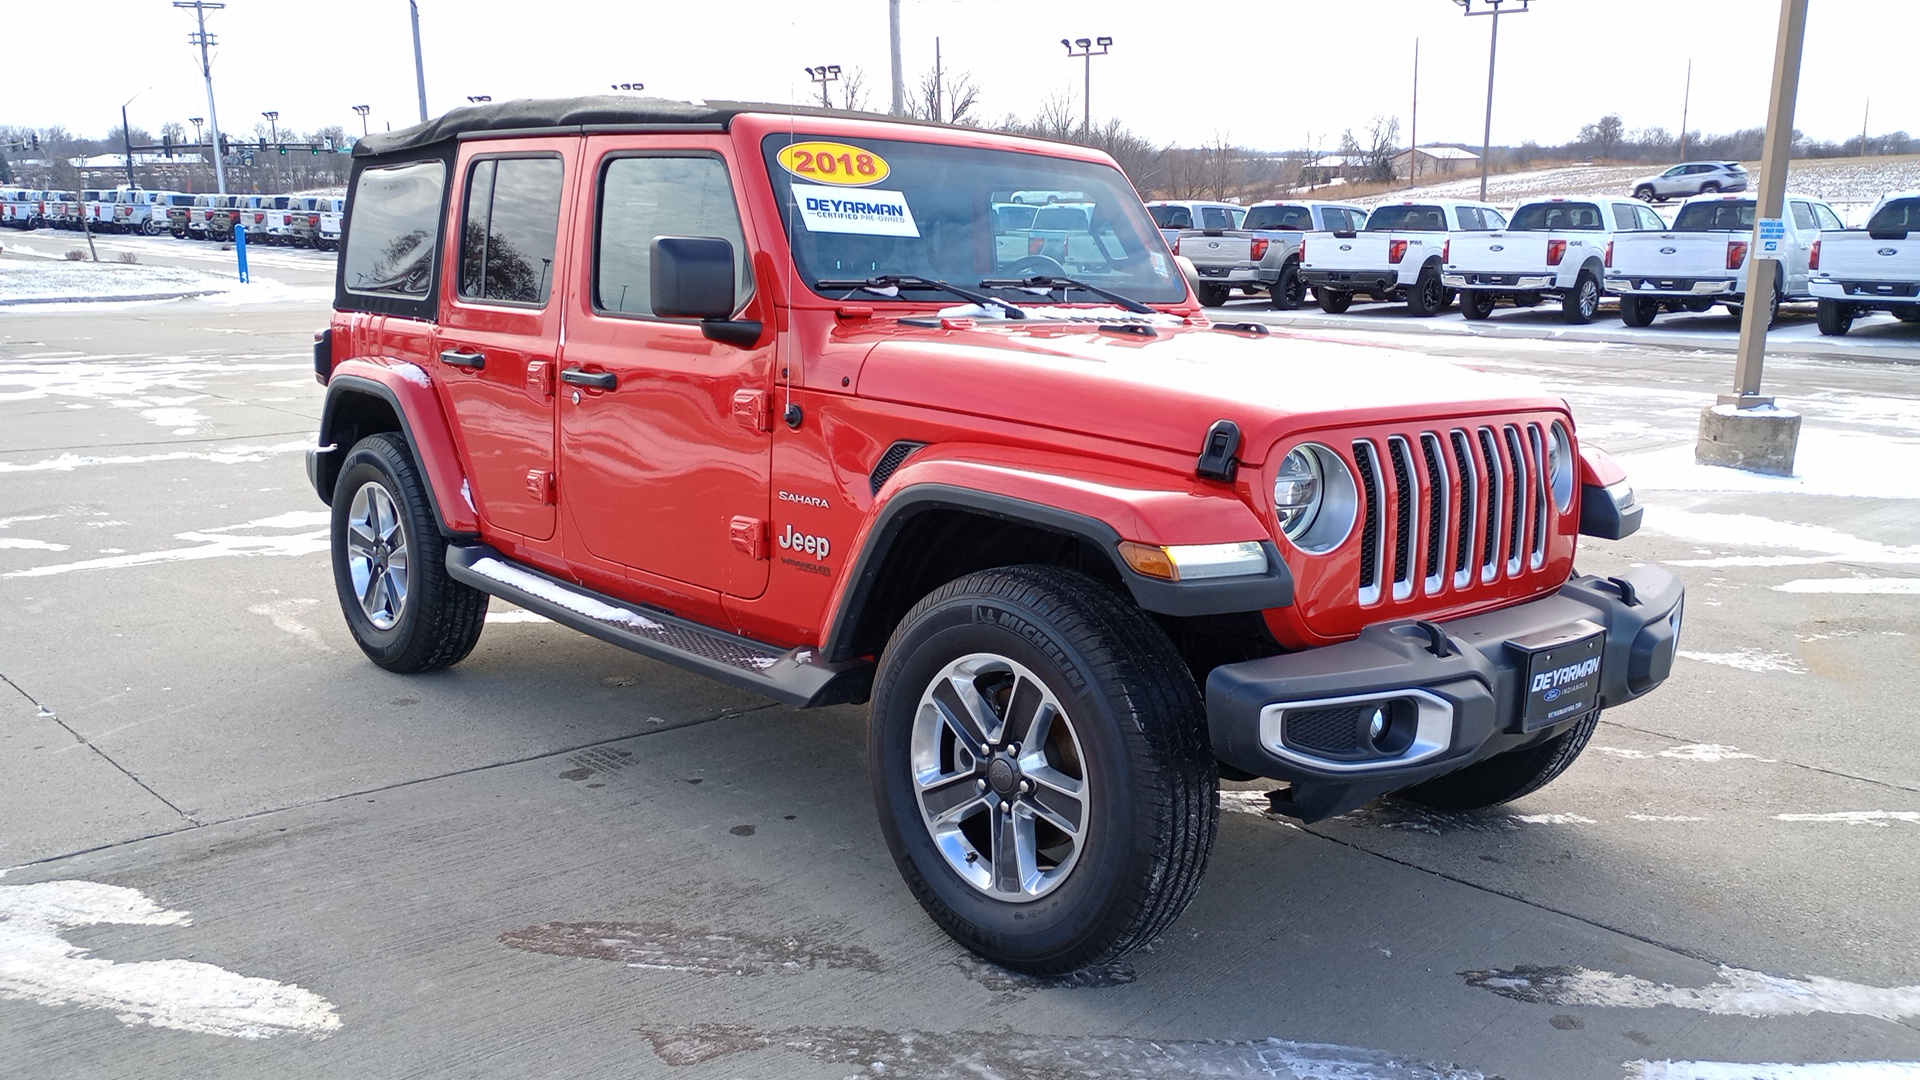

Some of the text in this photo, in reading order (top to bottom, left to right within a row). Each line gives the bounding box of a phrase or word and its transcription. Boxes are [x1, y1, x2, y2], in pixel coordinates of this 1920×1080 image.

[794, 151, 877, 176] 2018
[806, 198, 904, 217] DEYARMAN
[816, 211, 906, 224] CERTIFIED PRE-OWNED
[778, 490, 830, 509] SAHARA
[778, 524, 830, 561] Jeep
[999, 611, 1086, 688] MICHELIN
[1531, 656, 1601, 693] DEYARMAN
[1561, 681, 1588, 695] INDIANOLA
